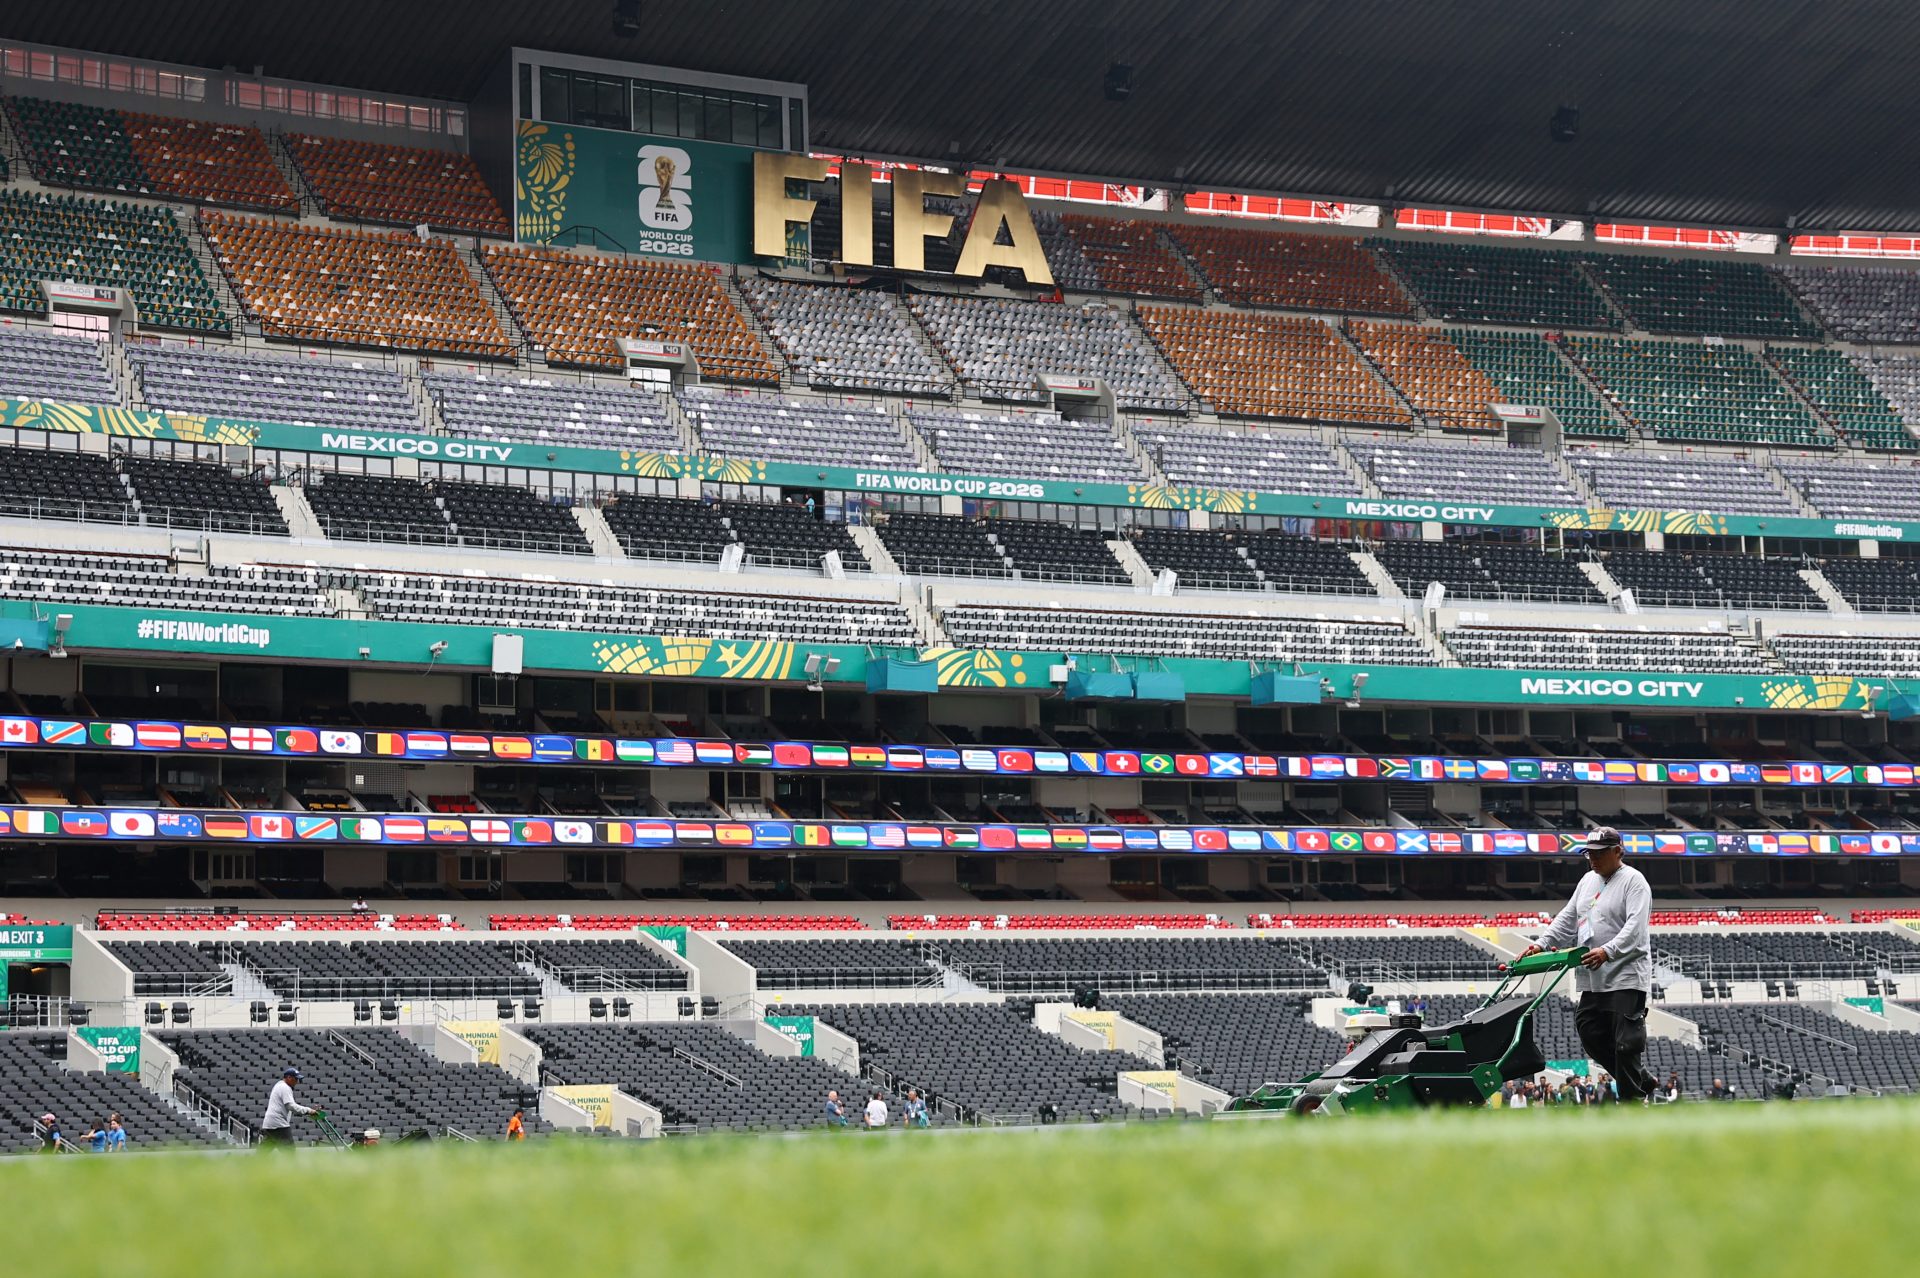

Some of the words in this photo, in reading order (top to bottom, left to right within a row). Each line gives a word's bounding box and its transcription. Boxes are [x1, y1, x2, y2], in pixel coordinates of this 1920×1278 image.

[655, 212, 678, 223] FIFA
[754, 152, 1055, 285] FIFA
[640, 230, 673, 241] WORLD
[675, 234, 693, 243] CUP
[640, 240, 693, 256] 2026
[322, 433, 439, 455] MEXICO
[445, 443, 512, 461] CITY
[856, 473, 891, 488] FIFA
[894, 475, 952, 492] WORLD
[954, 479, 986, 494] CUP
[988, 482, 1044, 497] 2026
[1346, 502, 1437, 518] MEXICO
[1441, 507, 1494, 521] CITY
[1834, 523, 1903, 540] #FIFAWorldCup
[138, 619, 270, 648] #FIFAWorldCup
[1521, 678, 1633, 696] MEXICO
[1638, 681, 1703, 697] CITY
[11, 931, 34, 944] EXIT
[36, 931, 44, 944] 3
[780, 1025, 798, 1033] FIFA
[796, 1033, 812, 1041] CUP
[96, 1045, 117, 1054] RLD
[117, 1045, 137, 1054] CUP
[98, 1037, 119, 1046] FIFA
